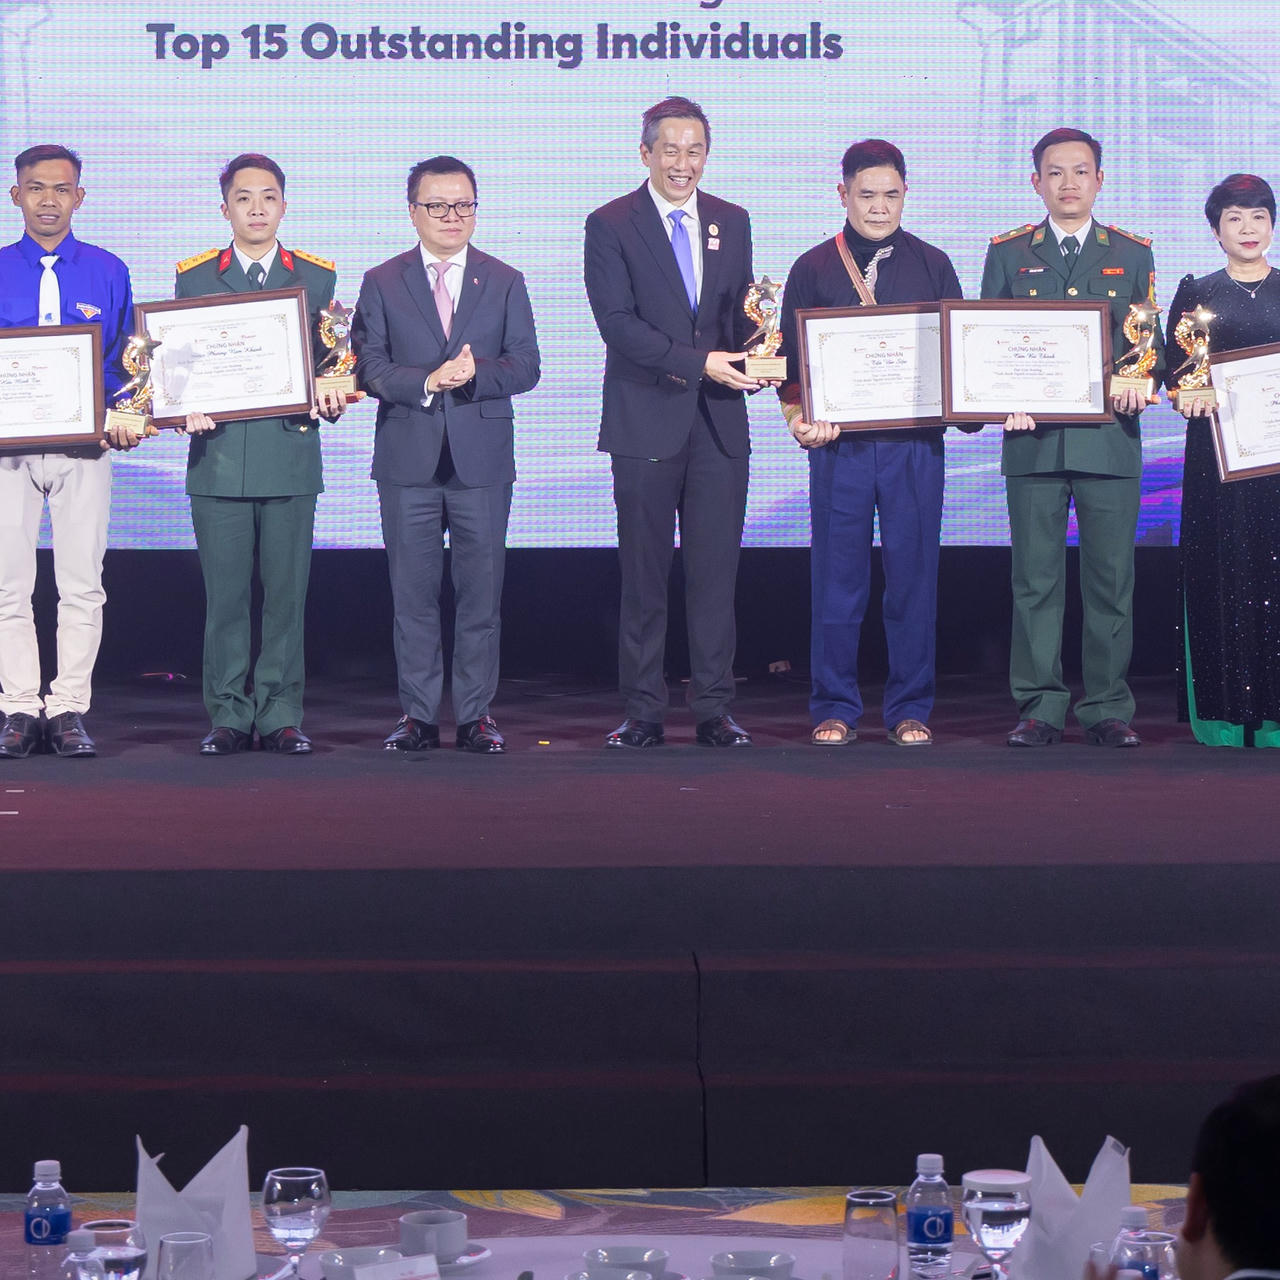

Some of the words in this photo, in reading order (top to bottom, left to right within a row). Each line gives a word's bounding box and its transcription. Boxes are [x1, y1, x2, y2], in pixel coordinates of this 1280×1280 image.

[145, 23, 230, 70] Top
[240, 23, 289, 60] 15
[300, 21, 583, 70] Outstanding
[596, 21, 844, 60] Individuals
